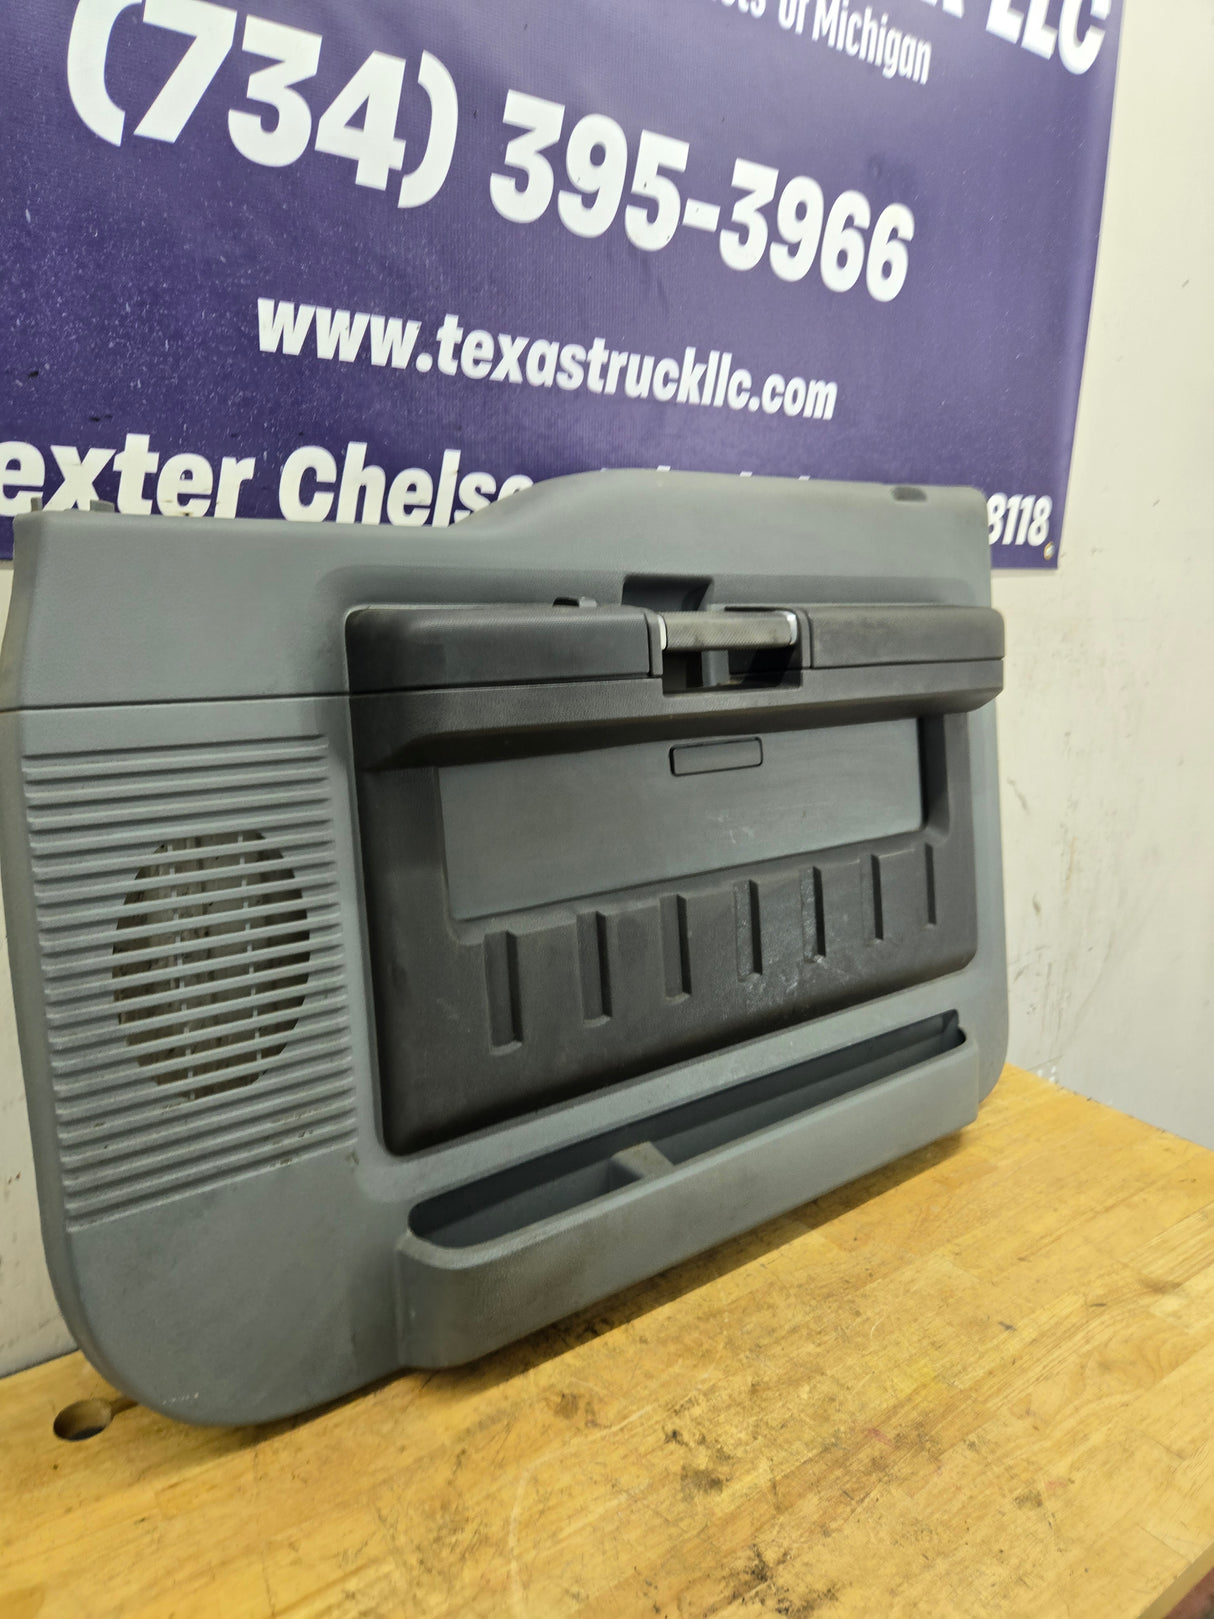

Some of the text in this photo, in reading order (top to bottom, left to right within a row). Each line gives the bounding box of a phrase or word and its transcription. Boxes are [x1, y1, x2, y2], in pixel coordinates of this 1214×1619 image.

[811, 0, 932, 85] Michigan
[67, 0, 915, 302] (734) 395-3966
[257, 297, 838, 421] www.texastruckllc.com
